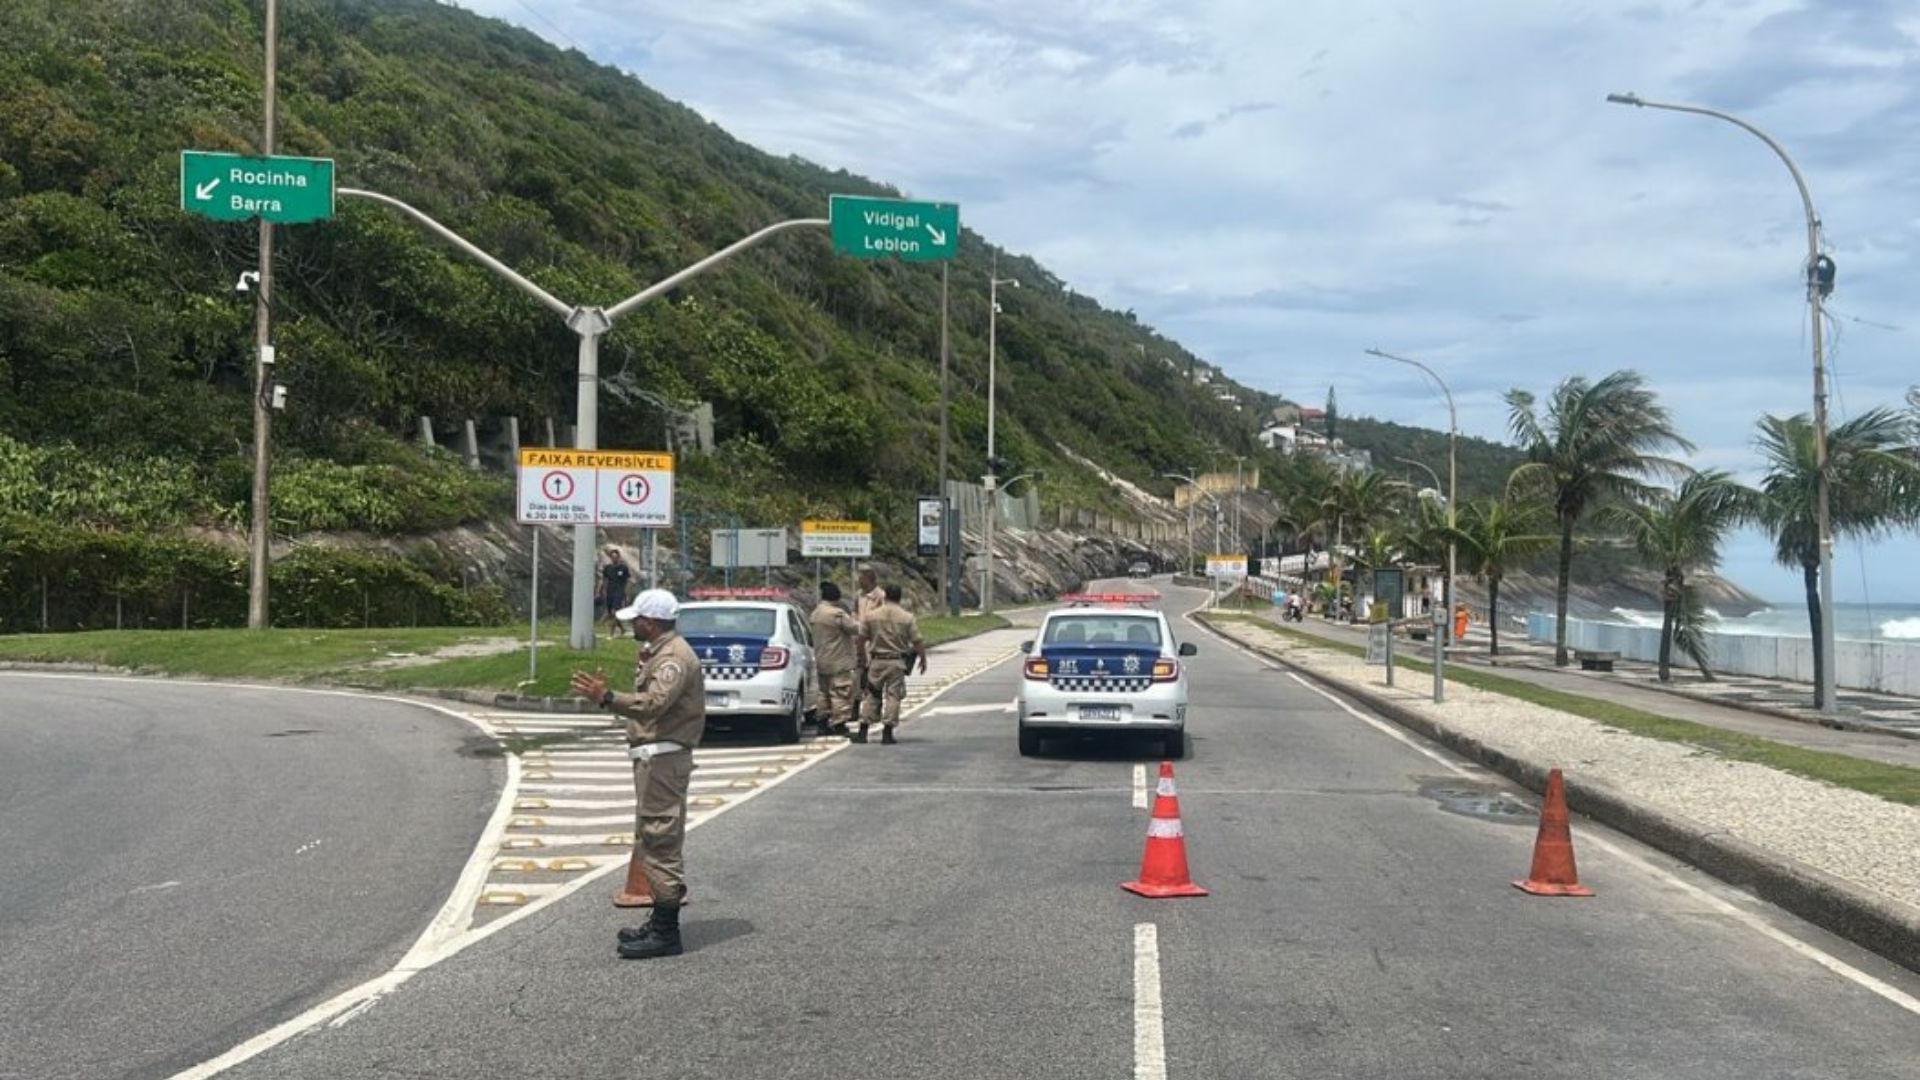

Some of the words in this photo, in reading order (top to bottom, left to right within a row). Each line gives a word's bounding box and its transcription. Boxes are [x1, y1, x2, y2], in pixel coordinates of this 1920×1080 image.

[230, 168, 307, 187] Rocinha
[231, 195, 282, 212] Barra
[864, 211, 920, 231] Vidigal
[864, 235, 920, 252] Leblon
[529, 453, 573, 466] FAIXA
[577, 454, 665, 468] REVERSÍVEL
